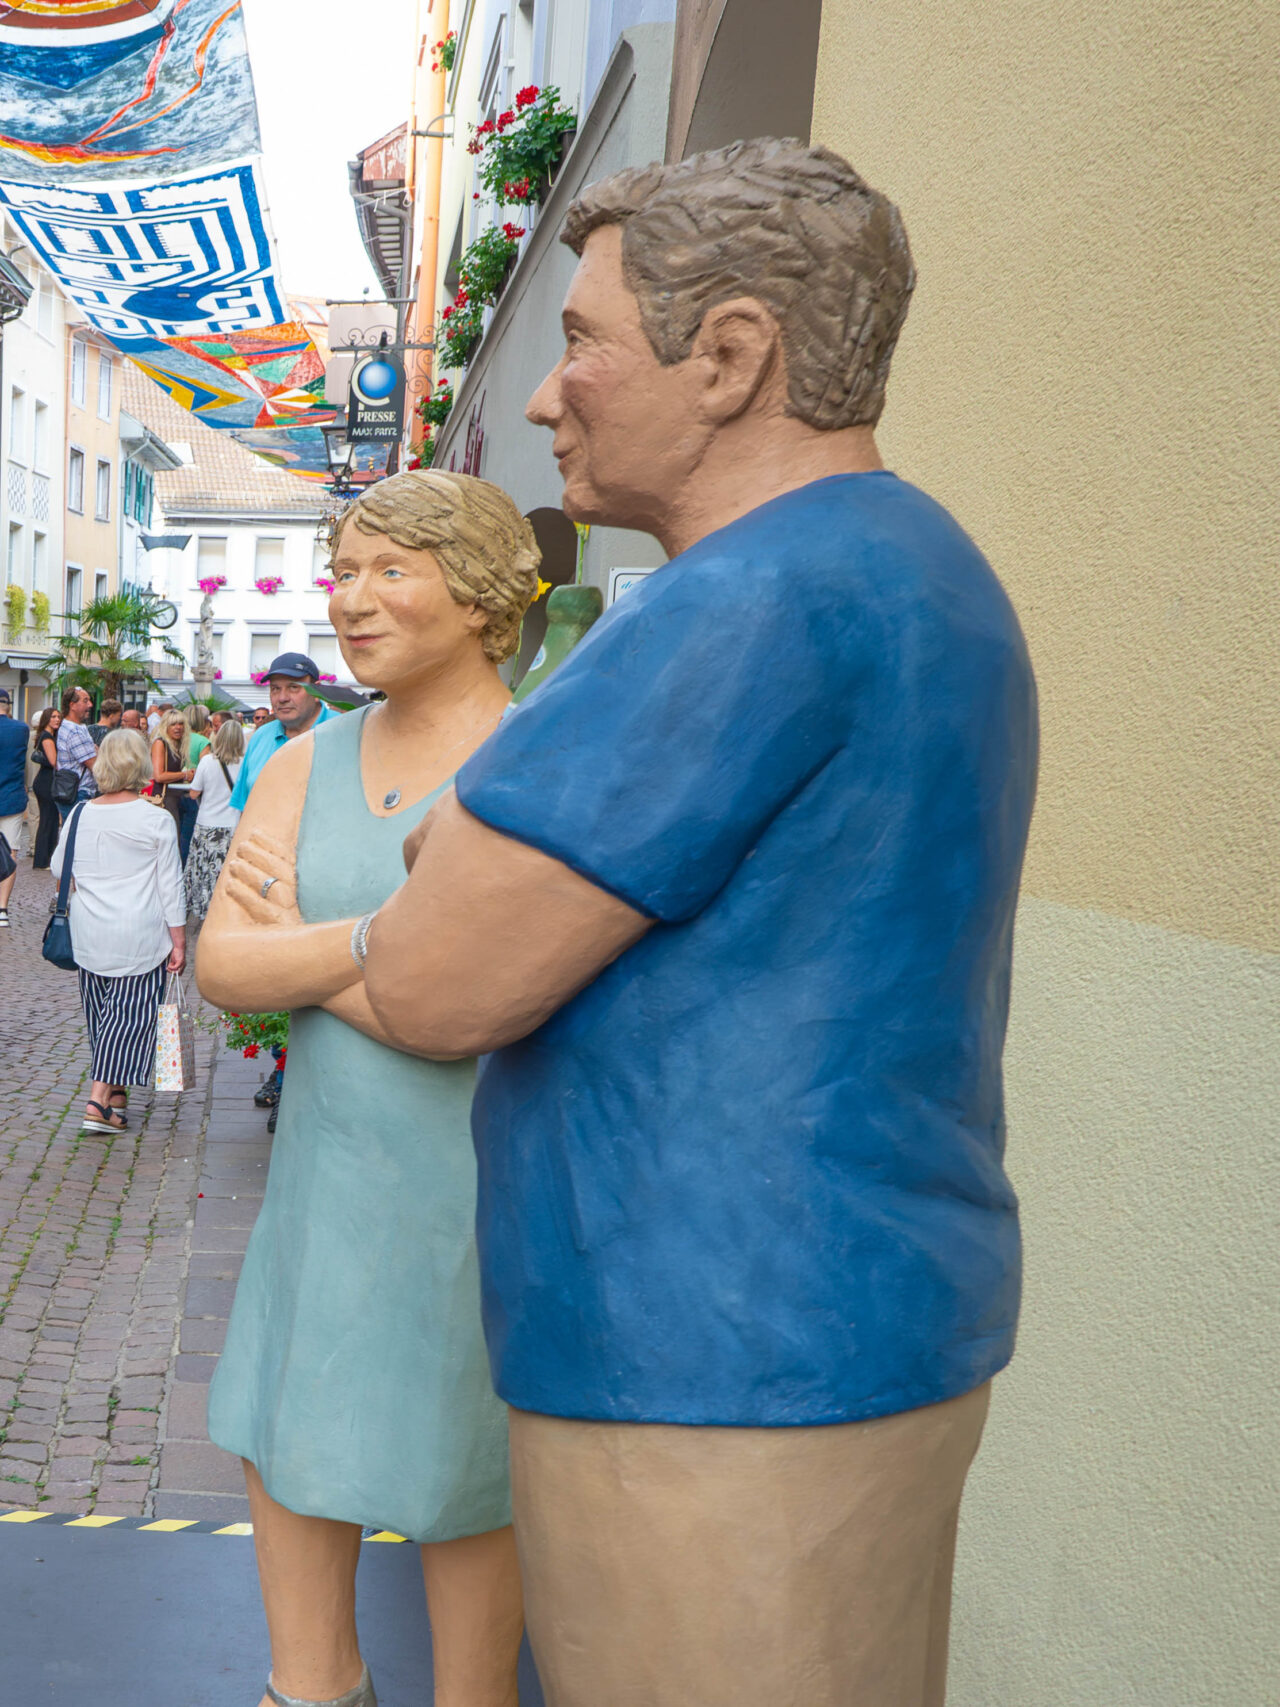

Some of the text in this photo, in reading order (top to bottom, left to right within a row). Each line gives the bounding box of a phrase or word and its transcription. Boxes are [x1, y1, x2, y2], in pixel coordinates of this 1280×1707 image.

[357, 411, 397, 422] PRESSE
[351, 427, 398, 436] MAX FRITZ
